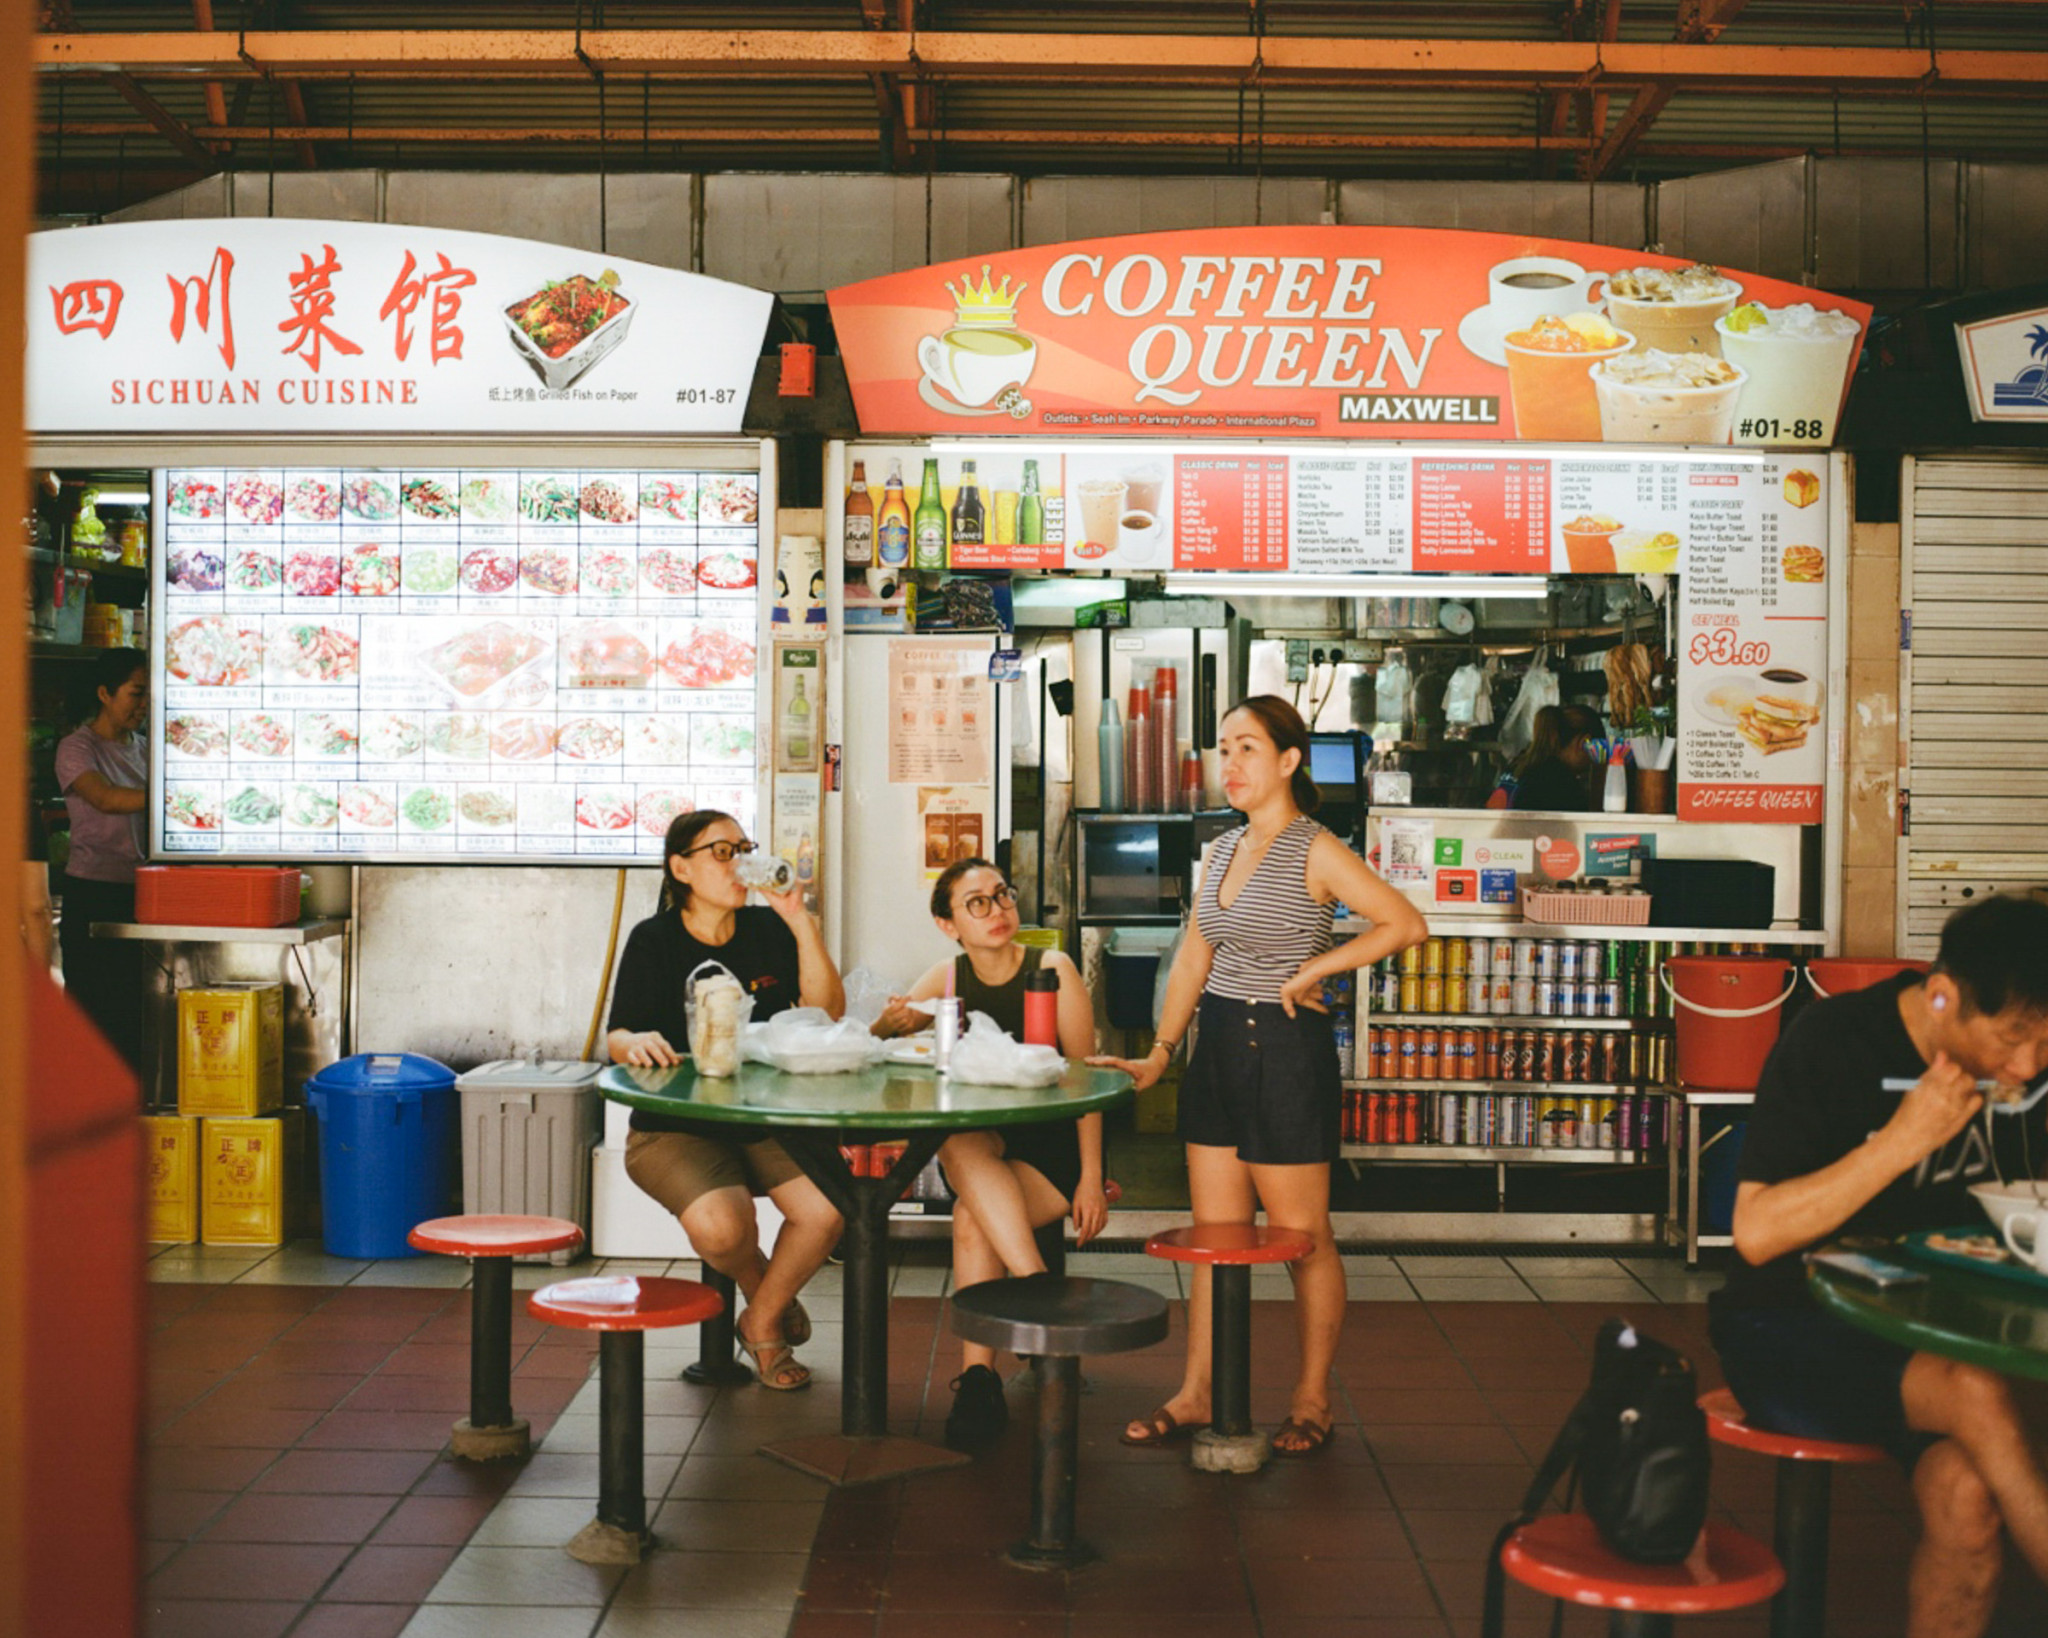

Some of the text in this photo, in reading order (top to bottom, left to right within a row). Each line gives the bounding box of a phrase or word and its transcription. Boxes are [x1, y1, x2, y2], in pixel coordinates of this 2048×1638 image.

[1041, 253, 1382, 320] COFFEE
[49, 244, 477, 372] 四川菜馆
[1128, 323, 1443, 407] QUEEN
[111, 379, 418, 405] SICHUAN CUISINE
[538, 389, 570, 401] Grilled
[572, 389, 593, 401] Fish
[596, 391, 608, 401] on
[610, 389, 638, 403] Paper
[676, 388, 737, 404] #01-87
[1139, 415, 1180, 427] Parkway
[1183, 415, 1217, 426] Parade
[1225, 416, 1286, 427] International
[1340, 397, 1497, 422] MAXWELL
[1739, 419, 1823, 439] #01-88
[1689, 628, 1770, 666] $3.60
[1691, 789, 1818, 810] COFFEE QUEEN
[1493, 852, 1524, 860] CLEAN
